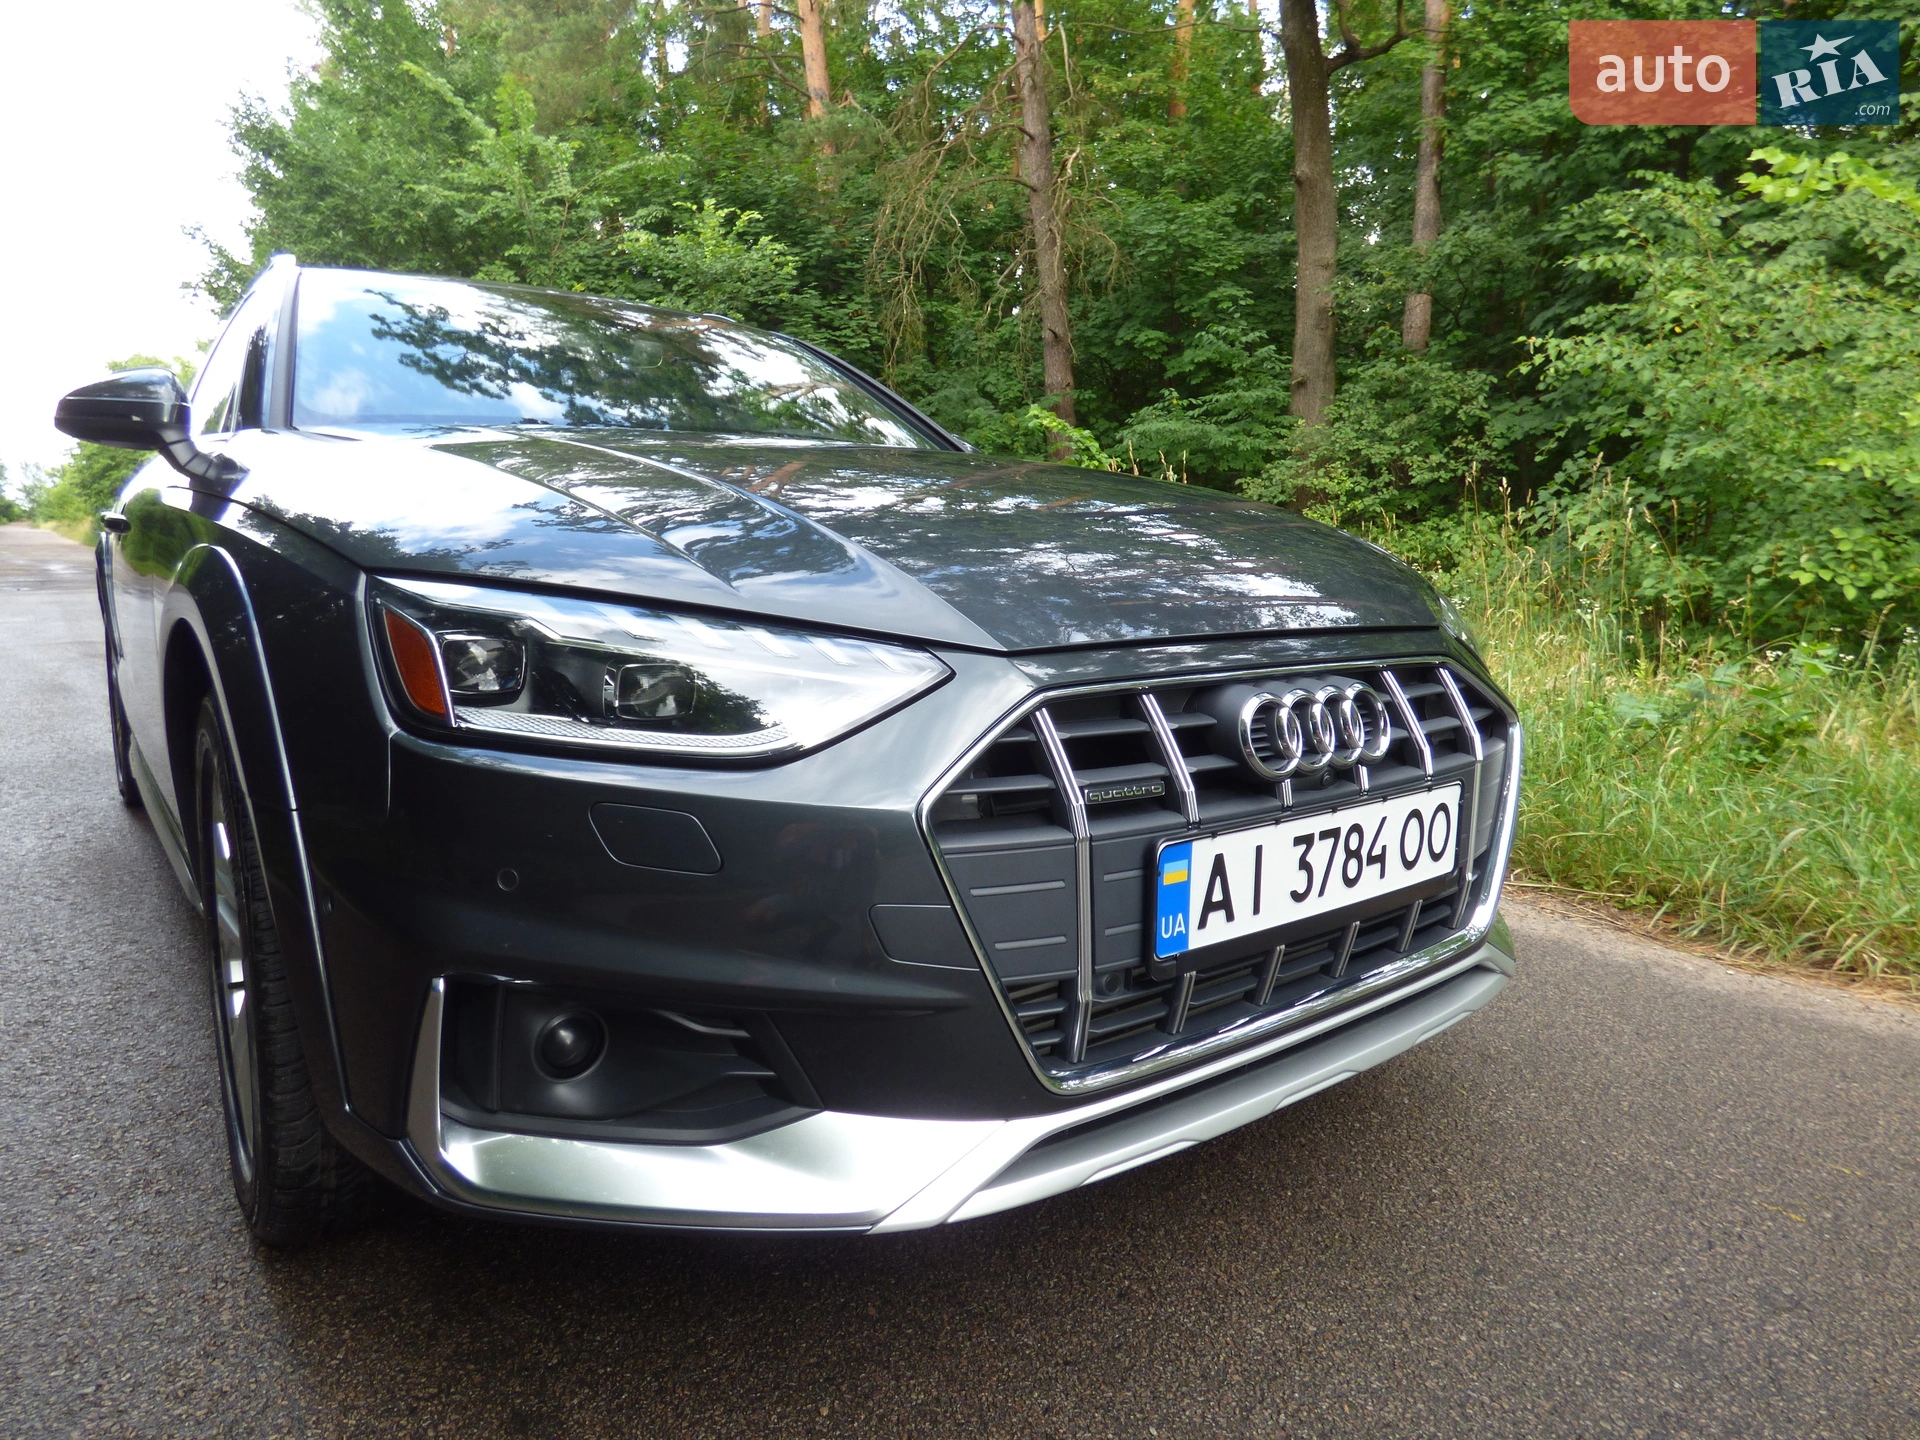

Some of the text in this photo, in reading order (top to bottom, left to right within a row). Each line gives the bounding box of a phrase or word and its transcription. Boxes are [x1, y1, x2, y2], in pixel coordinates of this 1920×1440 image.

[1089, 785, 1162, 802] quattro
[1289, 815, 1388, 904] 3784
[1161, 913, 1186, 939] UA
